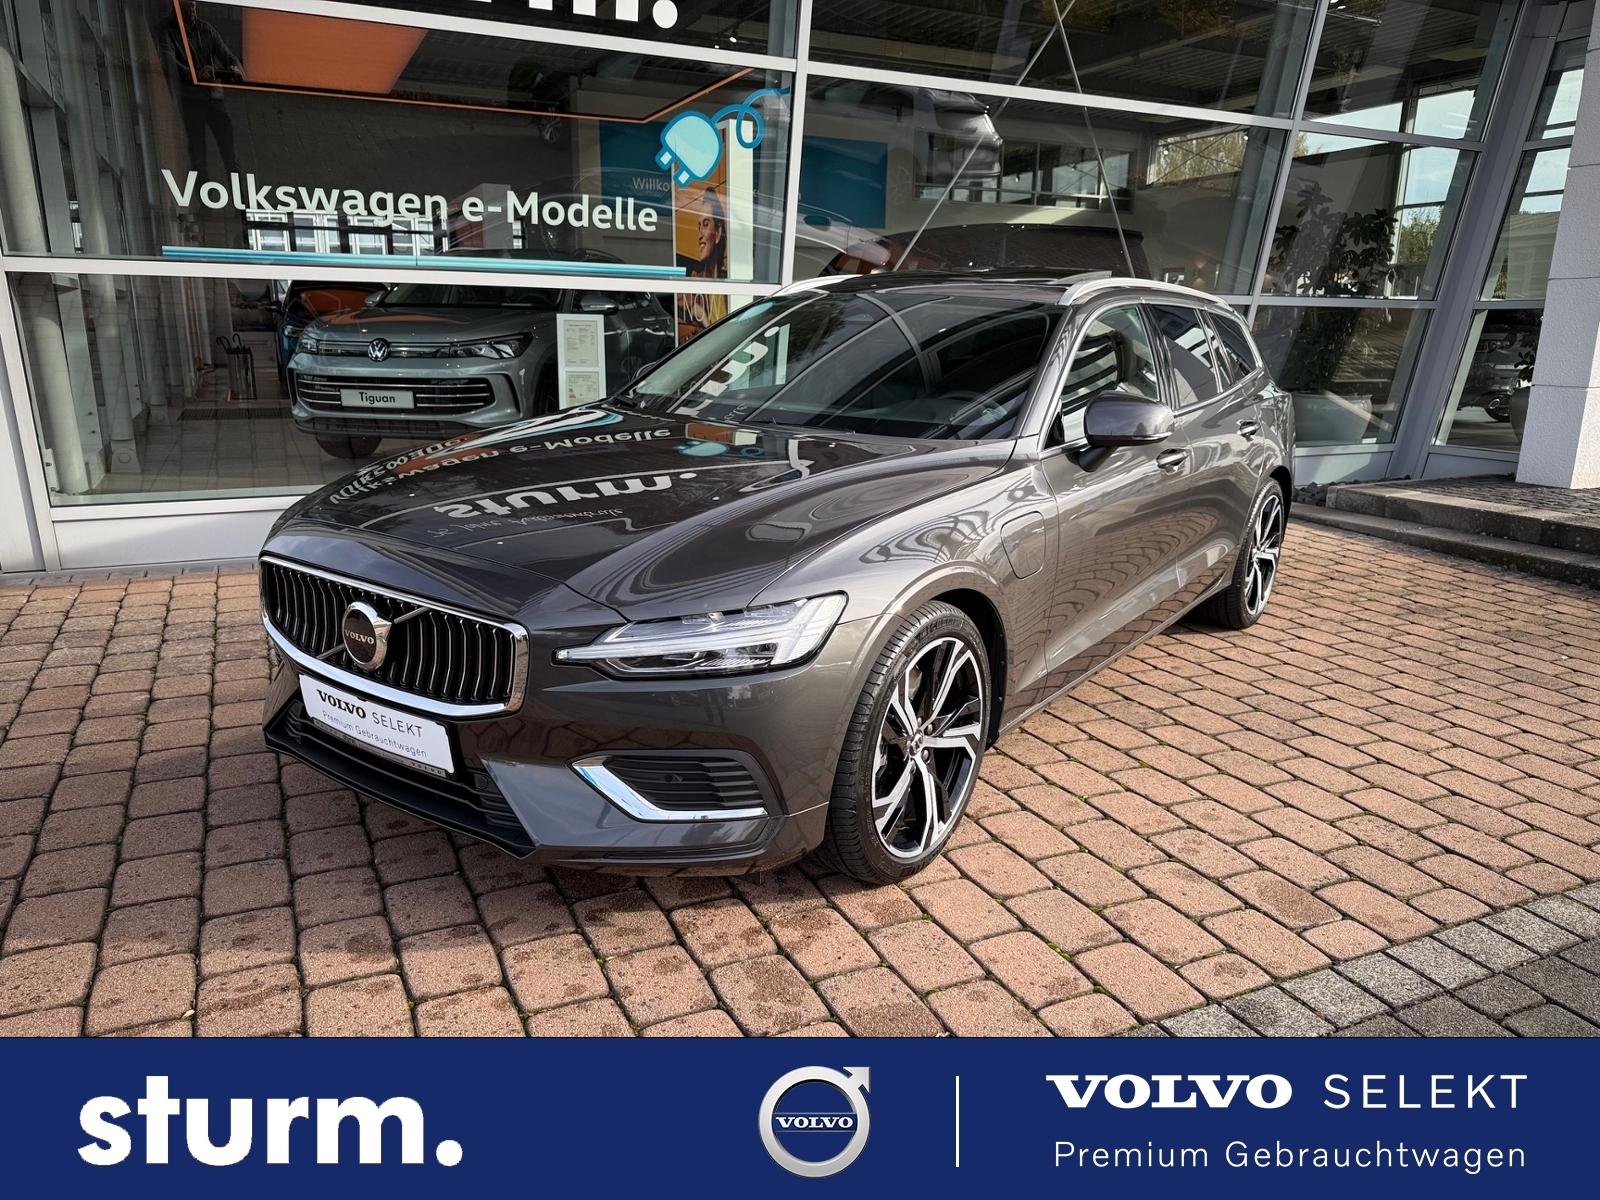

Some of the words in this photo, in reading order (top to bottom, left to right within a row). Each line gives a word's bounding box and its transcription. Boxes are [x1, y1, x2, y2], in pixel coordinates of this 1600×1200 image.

[632, 177, 672, 192] Willko
[161, 169, 448, 228] Volkswagen
[463, 190, 658, 233] e-Modelle
[358, 391, 396, 404] Tiguan
[345, 629, 375, 645] VOLVO
[316, 689, 366, 719] VOLVO
[372, 711, 423, 738] SELEKT
[322, 710, 354, 731] Premium
[355, 726, 427, 758] Gebrauchtwagen
